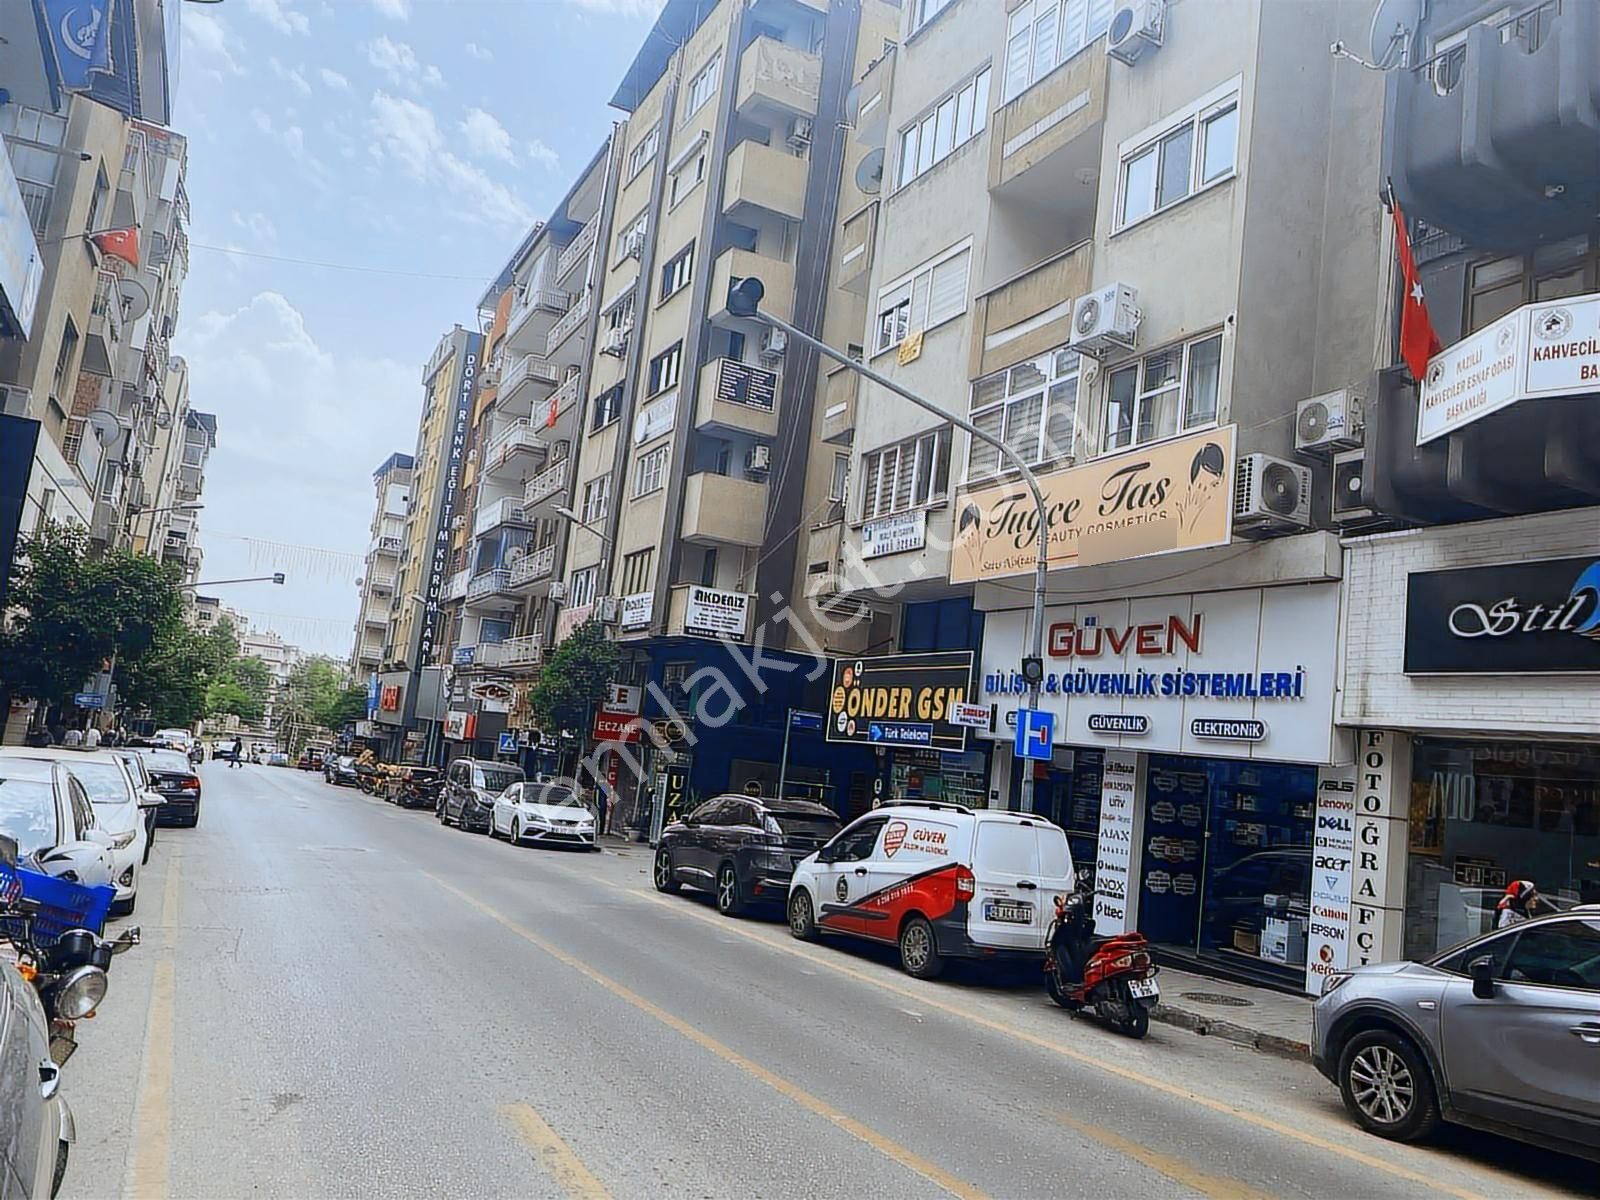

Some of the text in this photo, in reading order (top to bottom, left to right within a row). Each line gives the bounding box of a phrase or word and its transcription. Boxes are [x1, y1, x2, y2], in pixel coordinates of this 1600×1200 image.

[1467, 366, 1489, 391] ESNAF
[1491, 353, 1515, 378] ODASI
[452, 410, 467, 459] RENK
[422, 548, 446, 665] KURUMLARI
[1449, 595, 1588, 637] Stil
[1048, 614, 1203, 658] GÜVEN
[985, 665, 1304, 698] BİLİŞ & GÜVENLİK SİSTEMLERİ
[847, 680, 912, 718] ÖNDER
[917, 687, 963, 720] GSM
[598, 720, 638, 734] ECZANE
[1091, 714, 1145, 730] GÜVENLİK
[1193, 721, 1261, 737] ELEKTRONİK
[884, 727, 929, 741] Türk Telekom
[1319, 780, 1356, 792] ASUS
[1319, 797, 1354, 812] Lenovo
[1318, 816, 1352, 831] DELL
[1315, 855, 1351, 871] acer
[1312, 905, 1348, 921] Canon
[1311, 923, 1345, 940] EPSON
